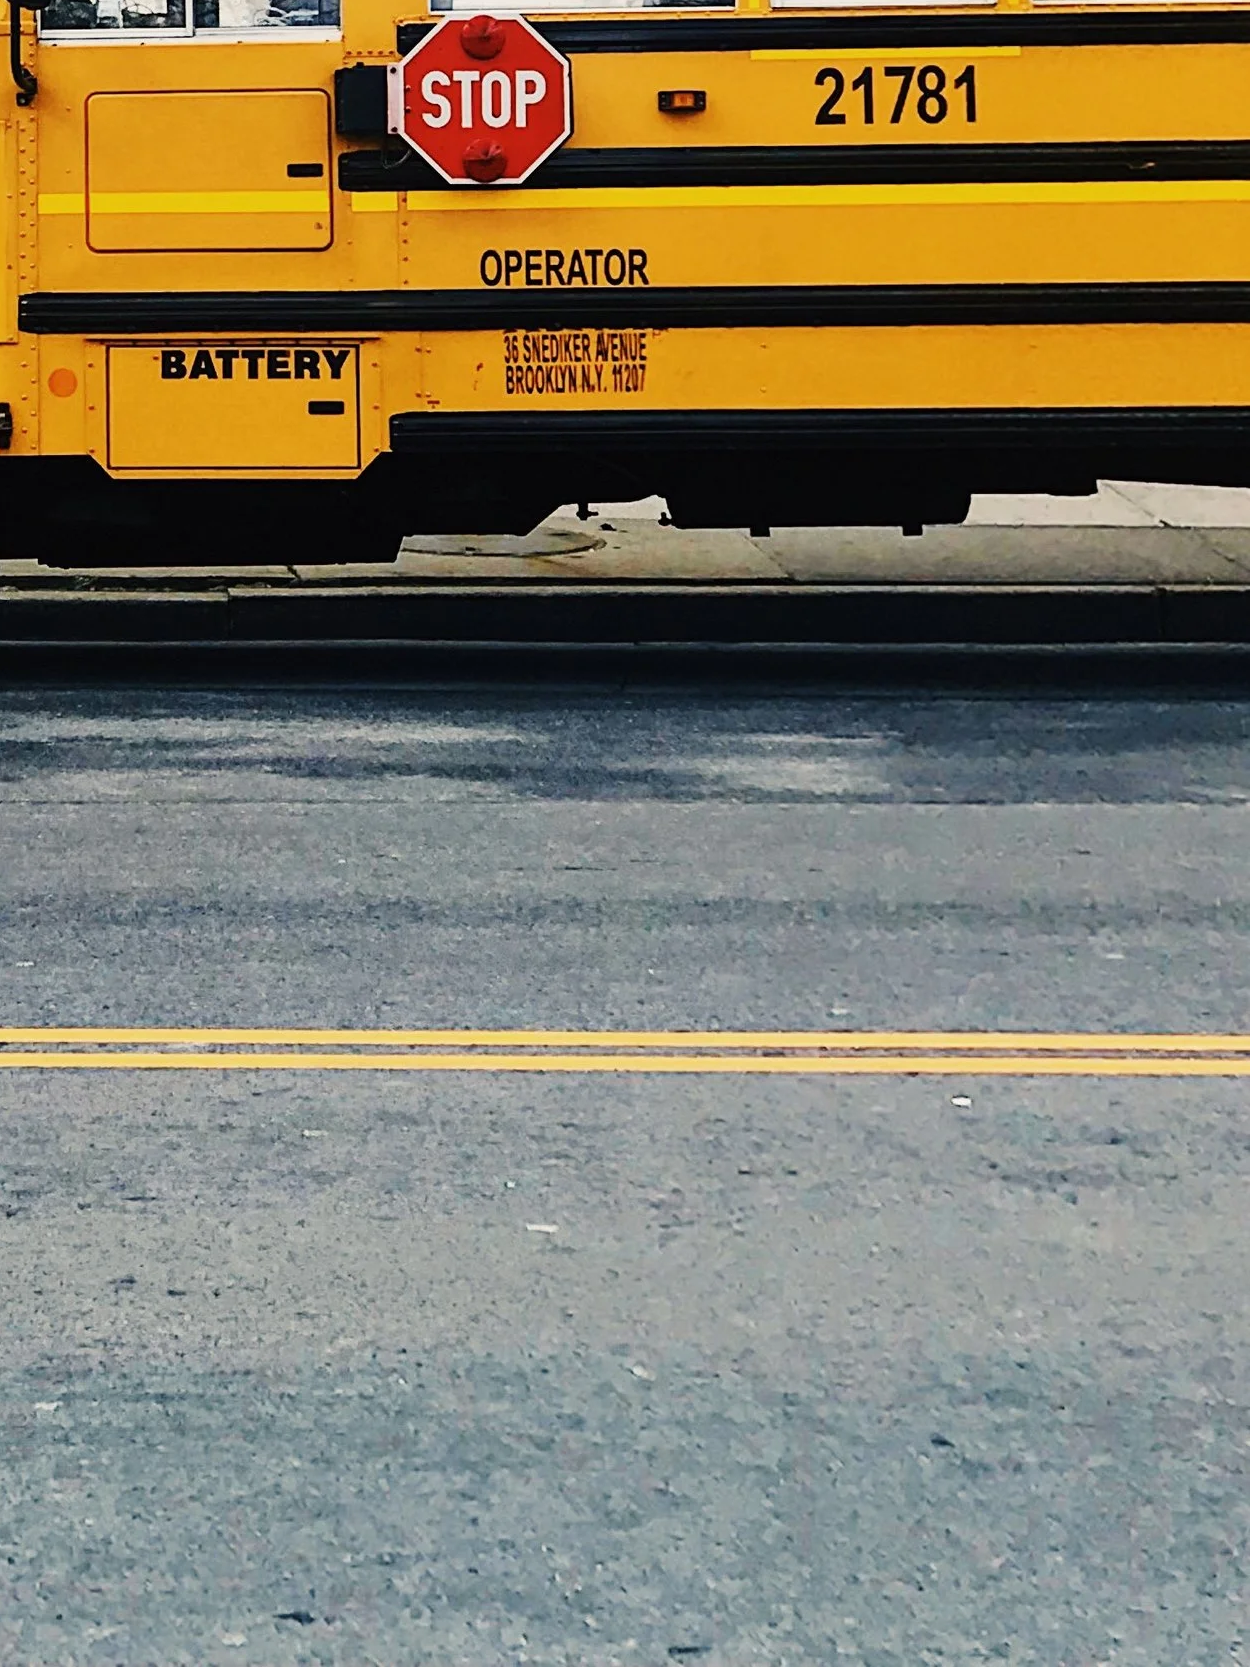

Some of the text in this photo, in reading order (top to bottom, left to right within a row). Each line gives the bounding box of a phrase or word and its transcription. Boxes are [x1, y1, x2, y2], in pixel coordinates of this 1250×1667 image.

[421, 70, 546, 128] STOP
[815, 65, 976, 125] 21781
[480, 249, 649, 286] OPERATOR
[161, 350, 350, 379] BATTERY
[504, 332, 647, 364] 36 SNEDIKER AVENUE
[506, 365, 577, 394] BROOKLYN
[612, 364, 646, 392] 11207
